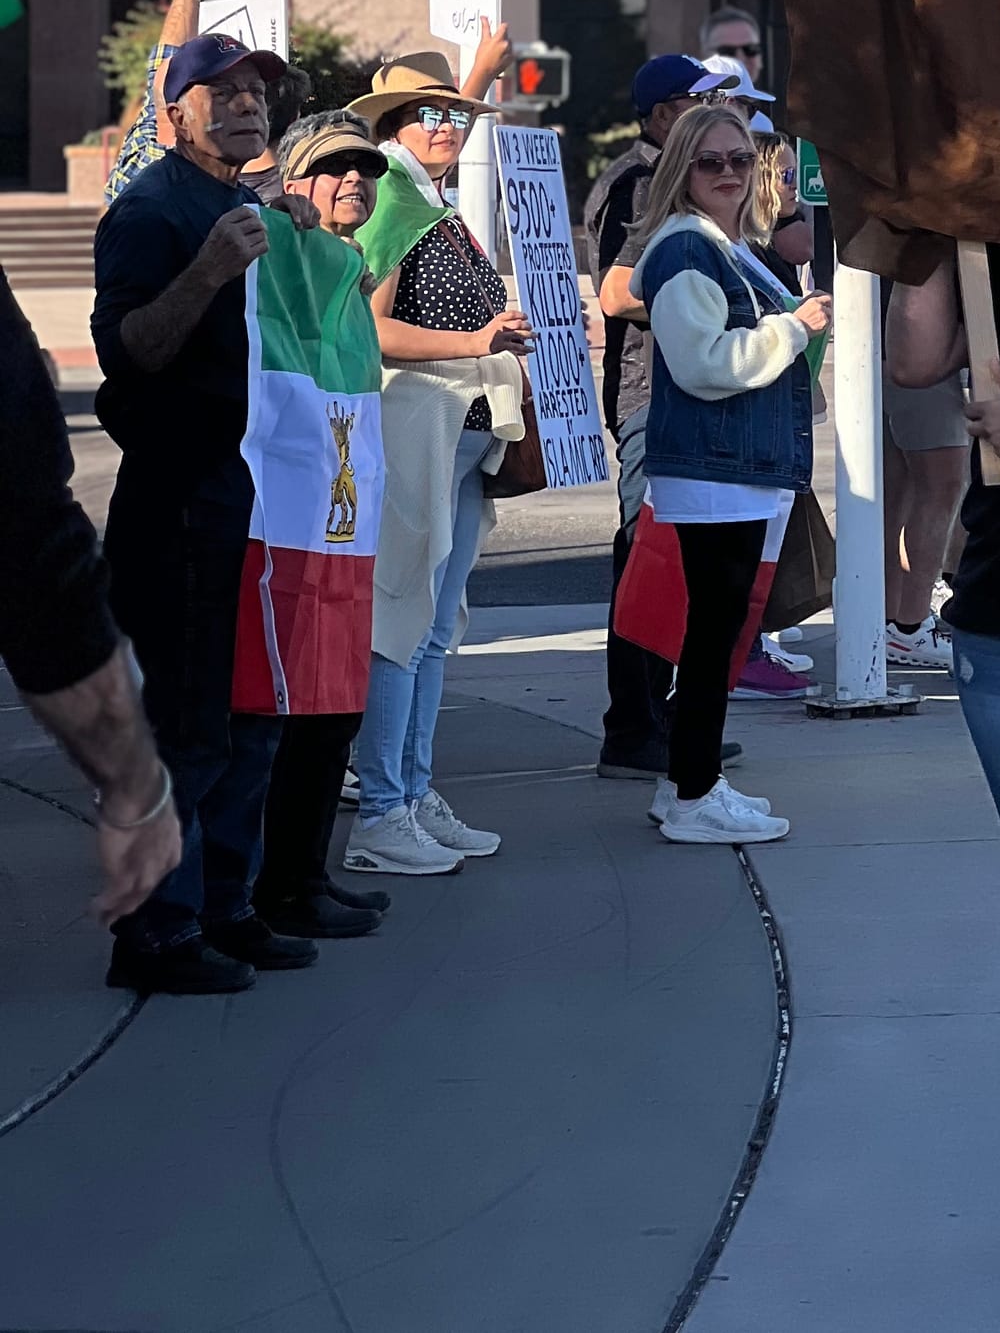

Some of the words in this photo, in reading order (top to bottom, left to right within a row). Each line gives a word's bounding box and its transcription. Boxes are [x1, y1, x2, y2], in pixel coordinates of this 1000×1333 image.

[512, 132, 521, 164] 3
[522, 242, 572, 271] PROTESTERS
[526, 272, 577, 328] KILLED
[538, 388, 588, 420] ARRESTED
[543, 434, 591, 489] ISLAMIC
